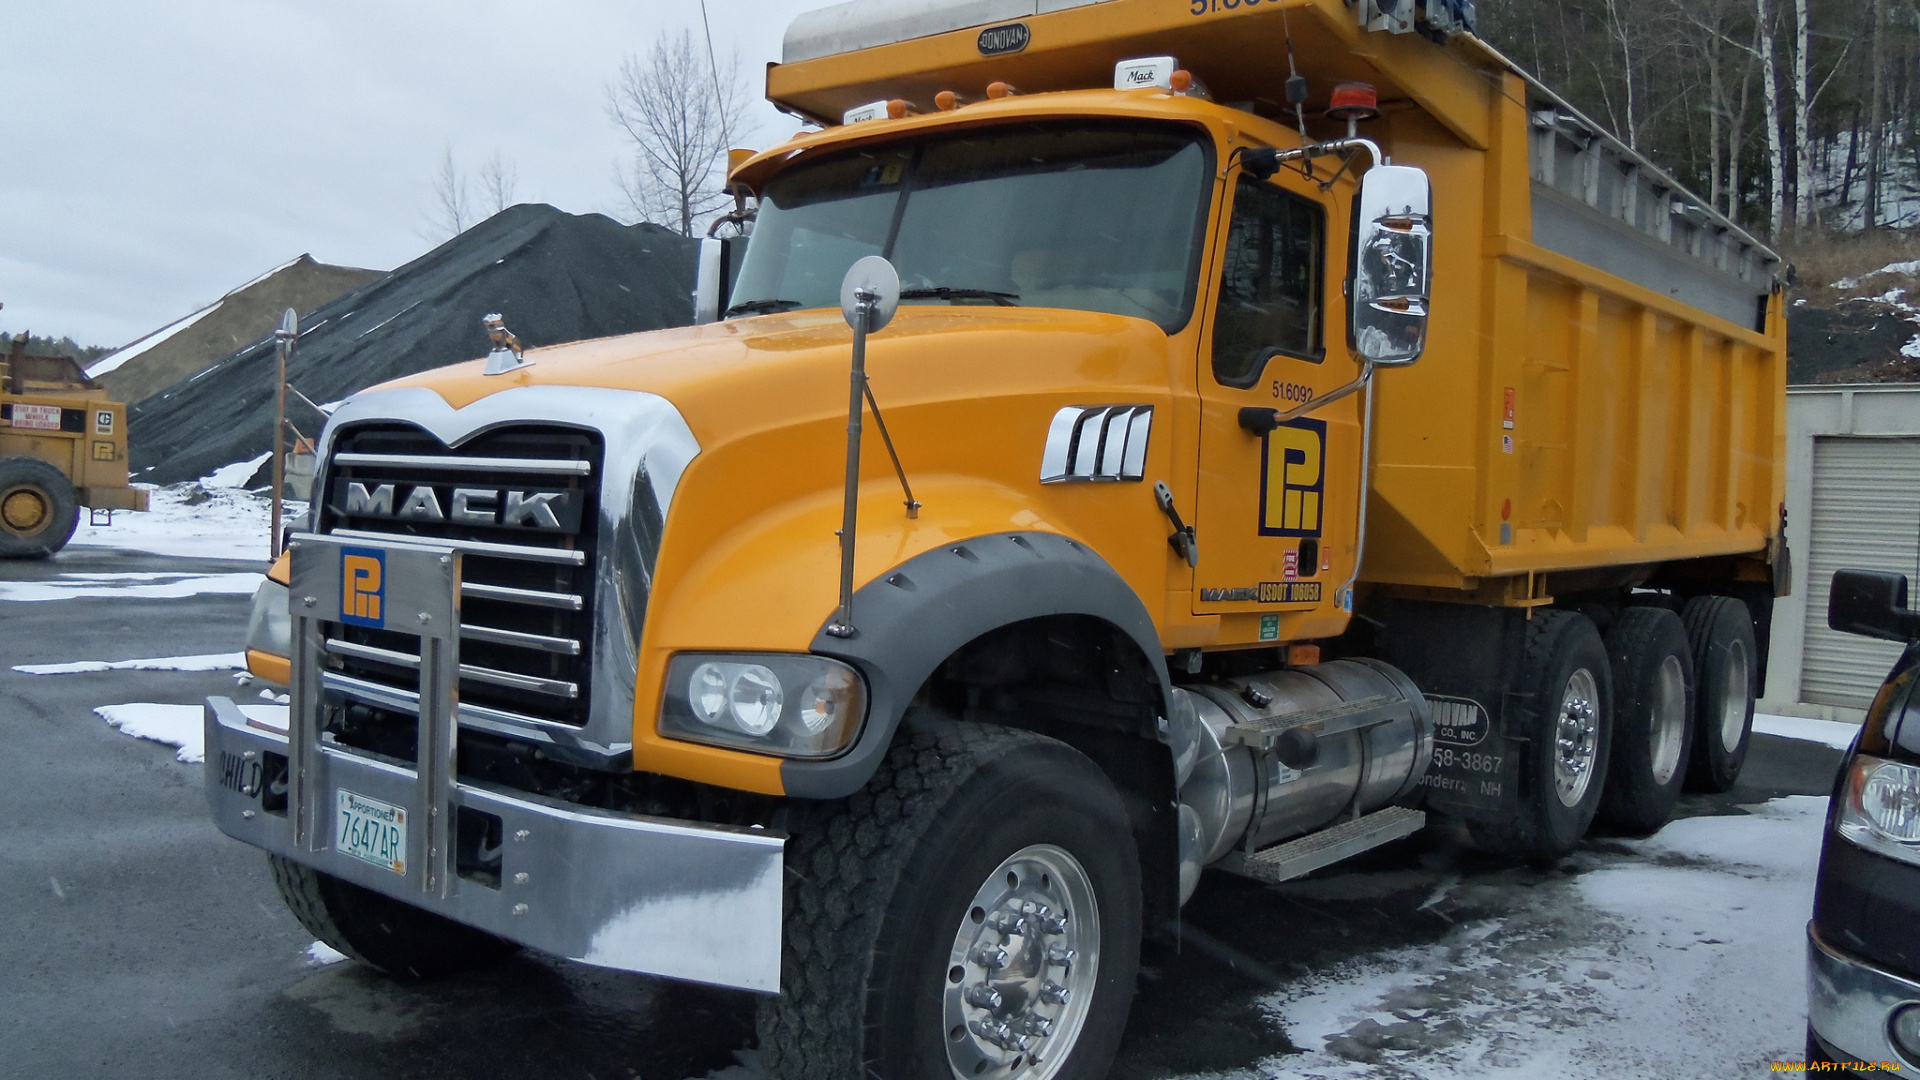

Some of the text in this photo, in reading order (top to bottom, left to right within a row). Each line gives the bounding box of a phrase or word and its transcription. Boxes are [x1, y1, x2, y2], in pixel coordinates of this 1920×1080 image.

[982, 28, 1023, 50] DONOVAN
[1127, 70, 1154, 84] Mack
[1272, 380, 1313, 403] 51.6092
[347, 482, 566, 528] MACK
[1260, 583, 1288, 601] USDOT
[342, 810, 400, 862] 7647AR
